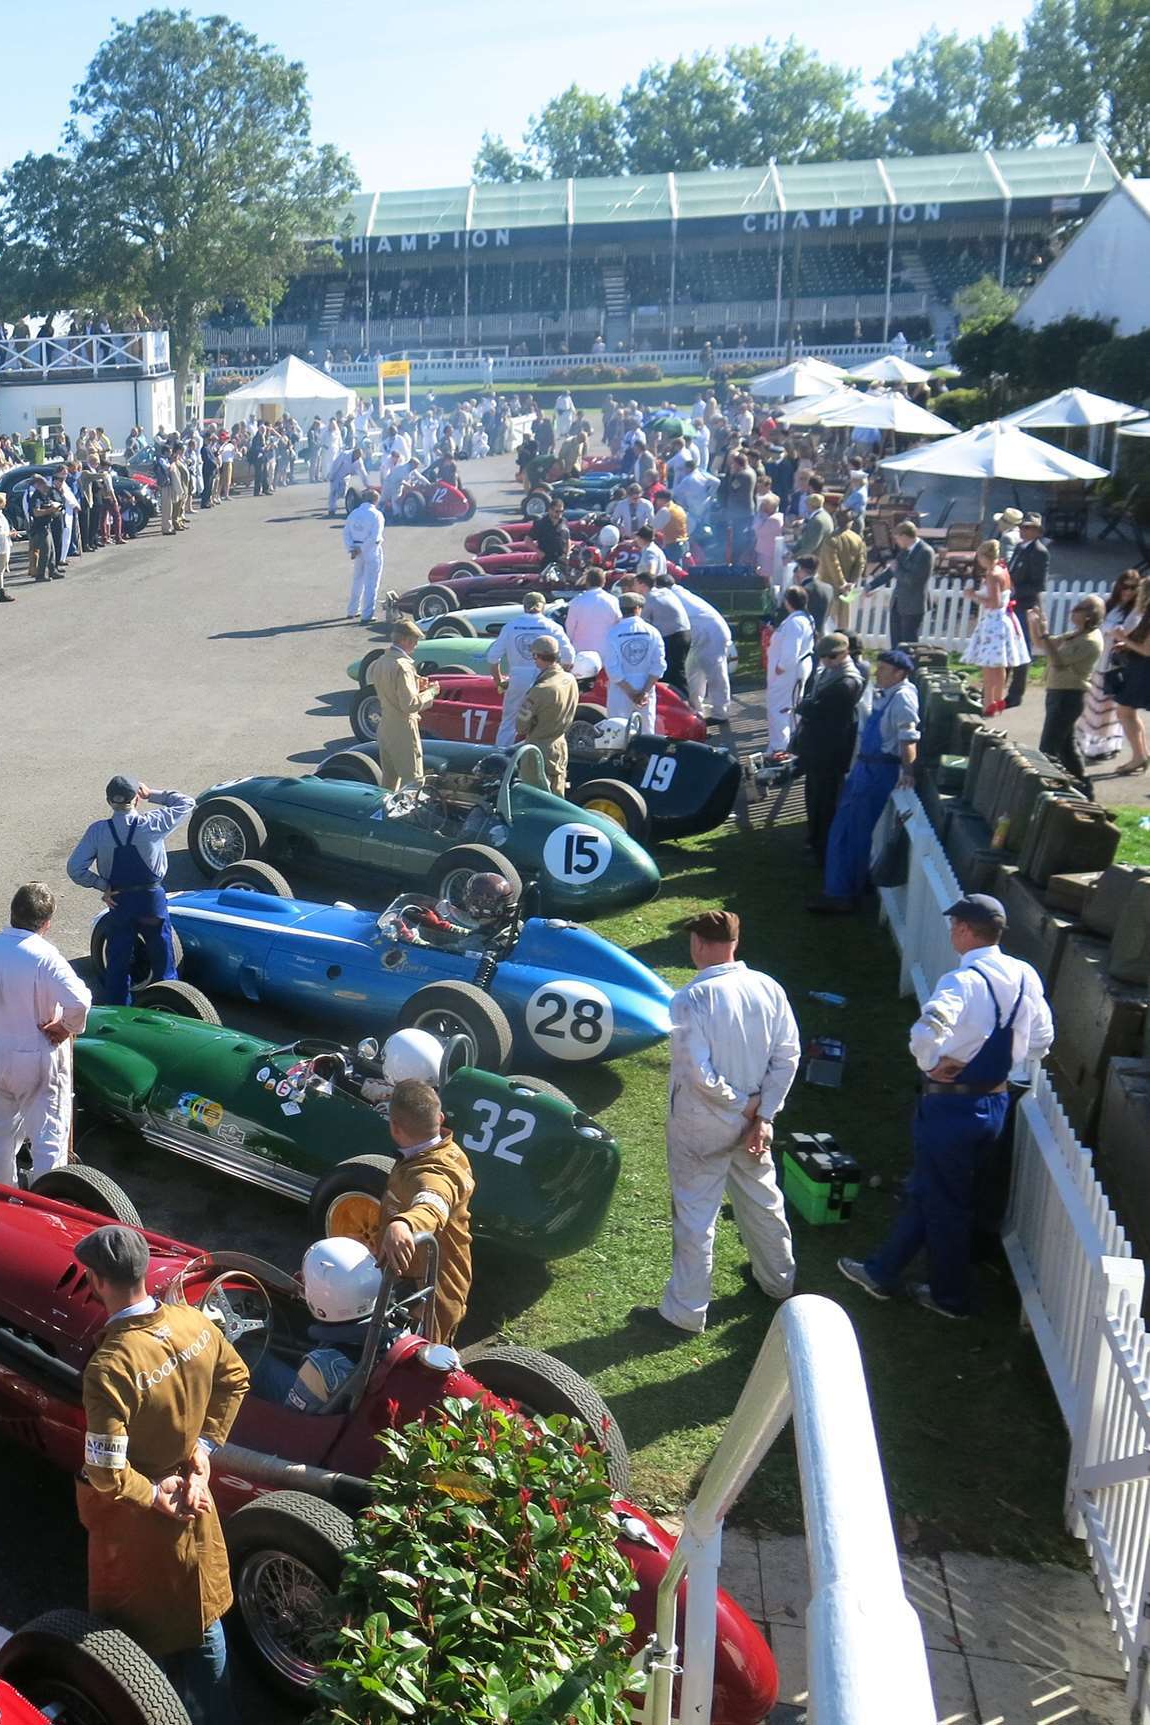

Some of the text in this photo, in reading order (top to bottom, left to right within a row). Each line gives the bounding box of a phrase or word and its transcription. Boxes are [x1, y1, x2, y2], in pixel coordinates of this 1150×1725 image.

[742, 203, 940, 233] CHAMPION
[332, 229, 510, 256] CHAMPION
[461, 709, 489, 740] 17
[640, 754, 677, 792] 19
[564, 834, 599, 875] 15
[534, 992, 603, 1044] 28
[462, 1098, 536, 1165] 32
